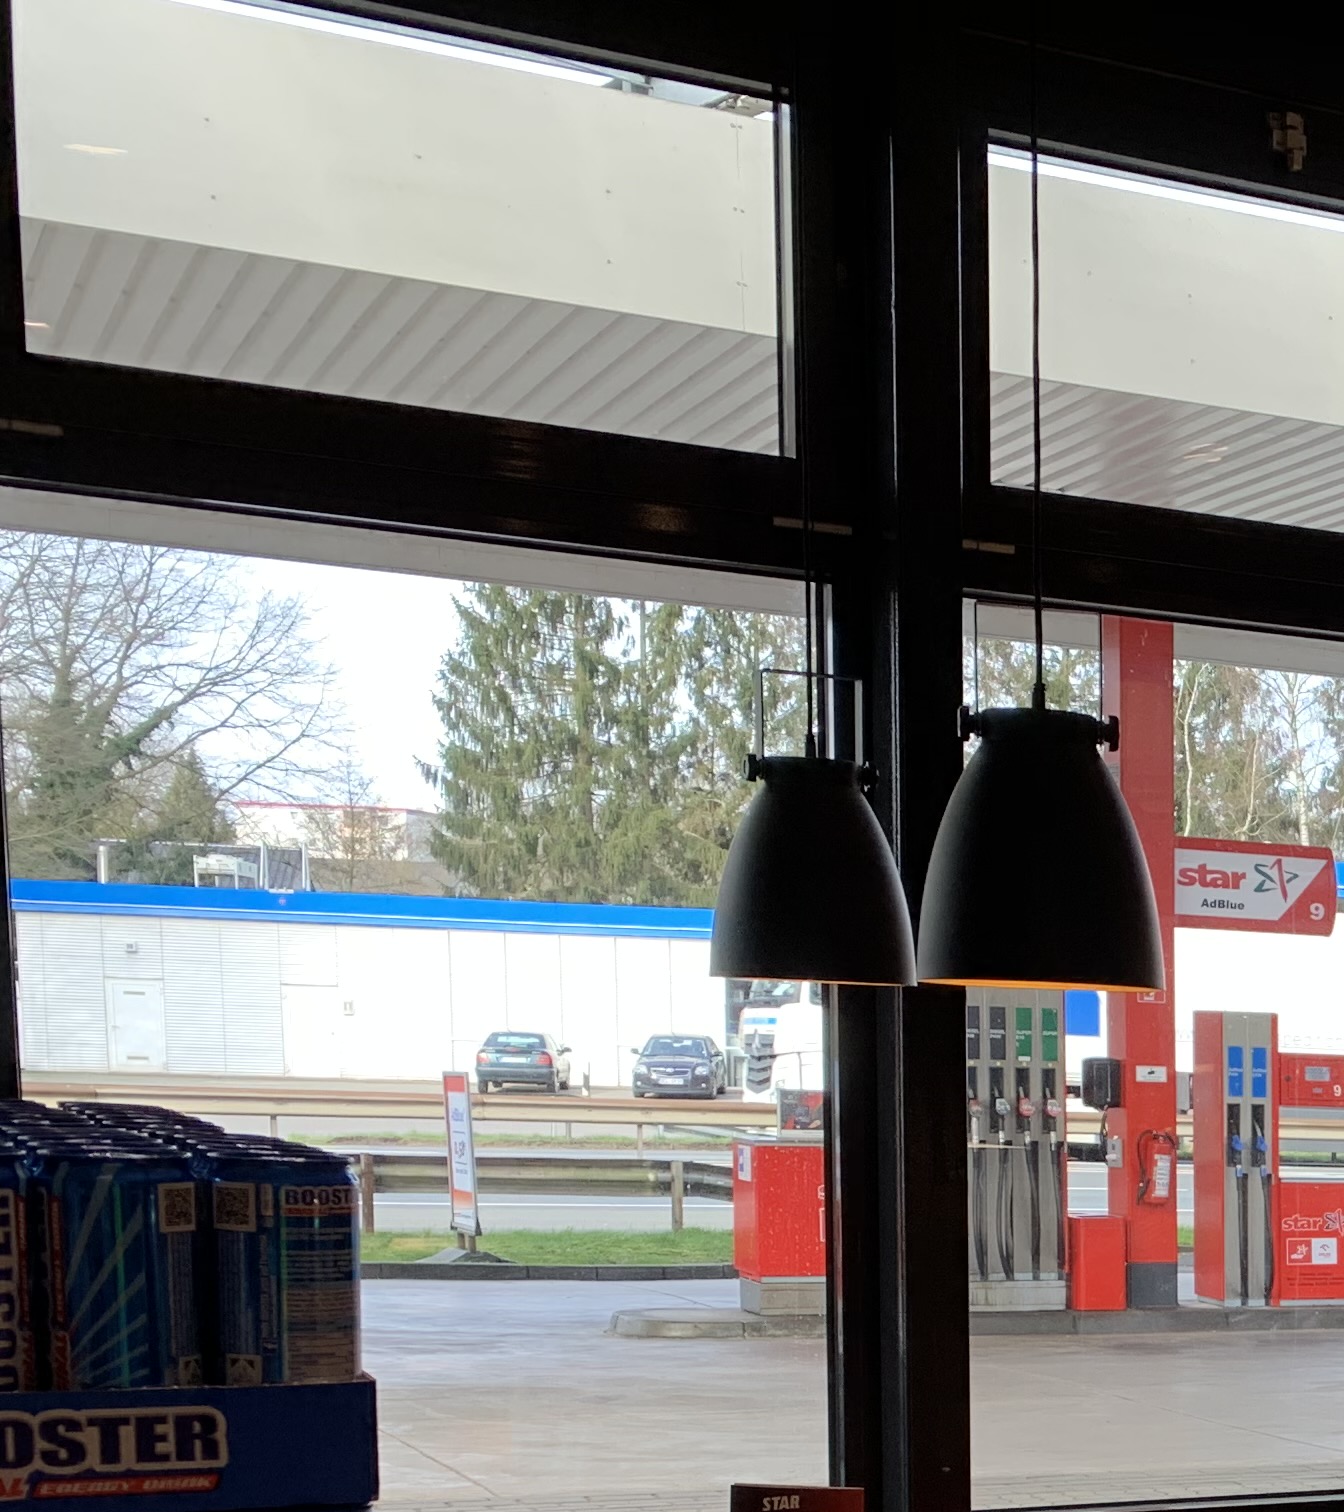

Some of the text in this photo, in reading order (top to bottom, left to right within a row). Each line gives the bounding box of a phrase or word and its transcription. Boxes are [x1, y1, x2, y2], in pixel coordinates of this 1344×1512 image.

[1177, 863, 1247, 890] star
[1200, 898, 1245, 911] AdBlue
[1309, 903, 1325, 921] 9
[1332, 1084, 1342, 1097] 9
[285, 1188, 350, 1206] BOOST
[1282, 1213, 1323, 1231] star
[0, 1414, 220, 1469] OSTER
[762, 1494, 801, 1512] STAR
